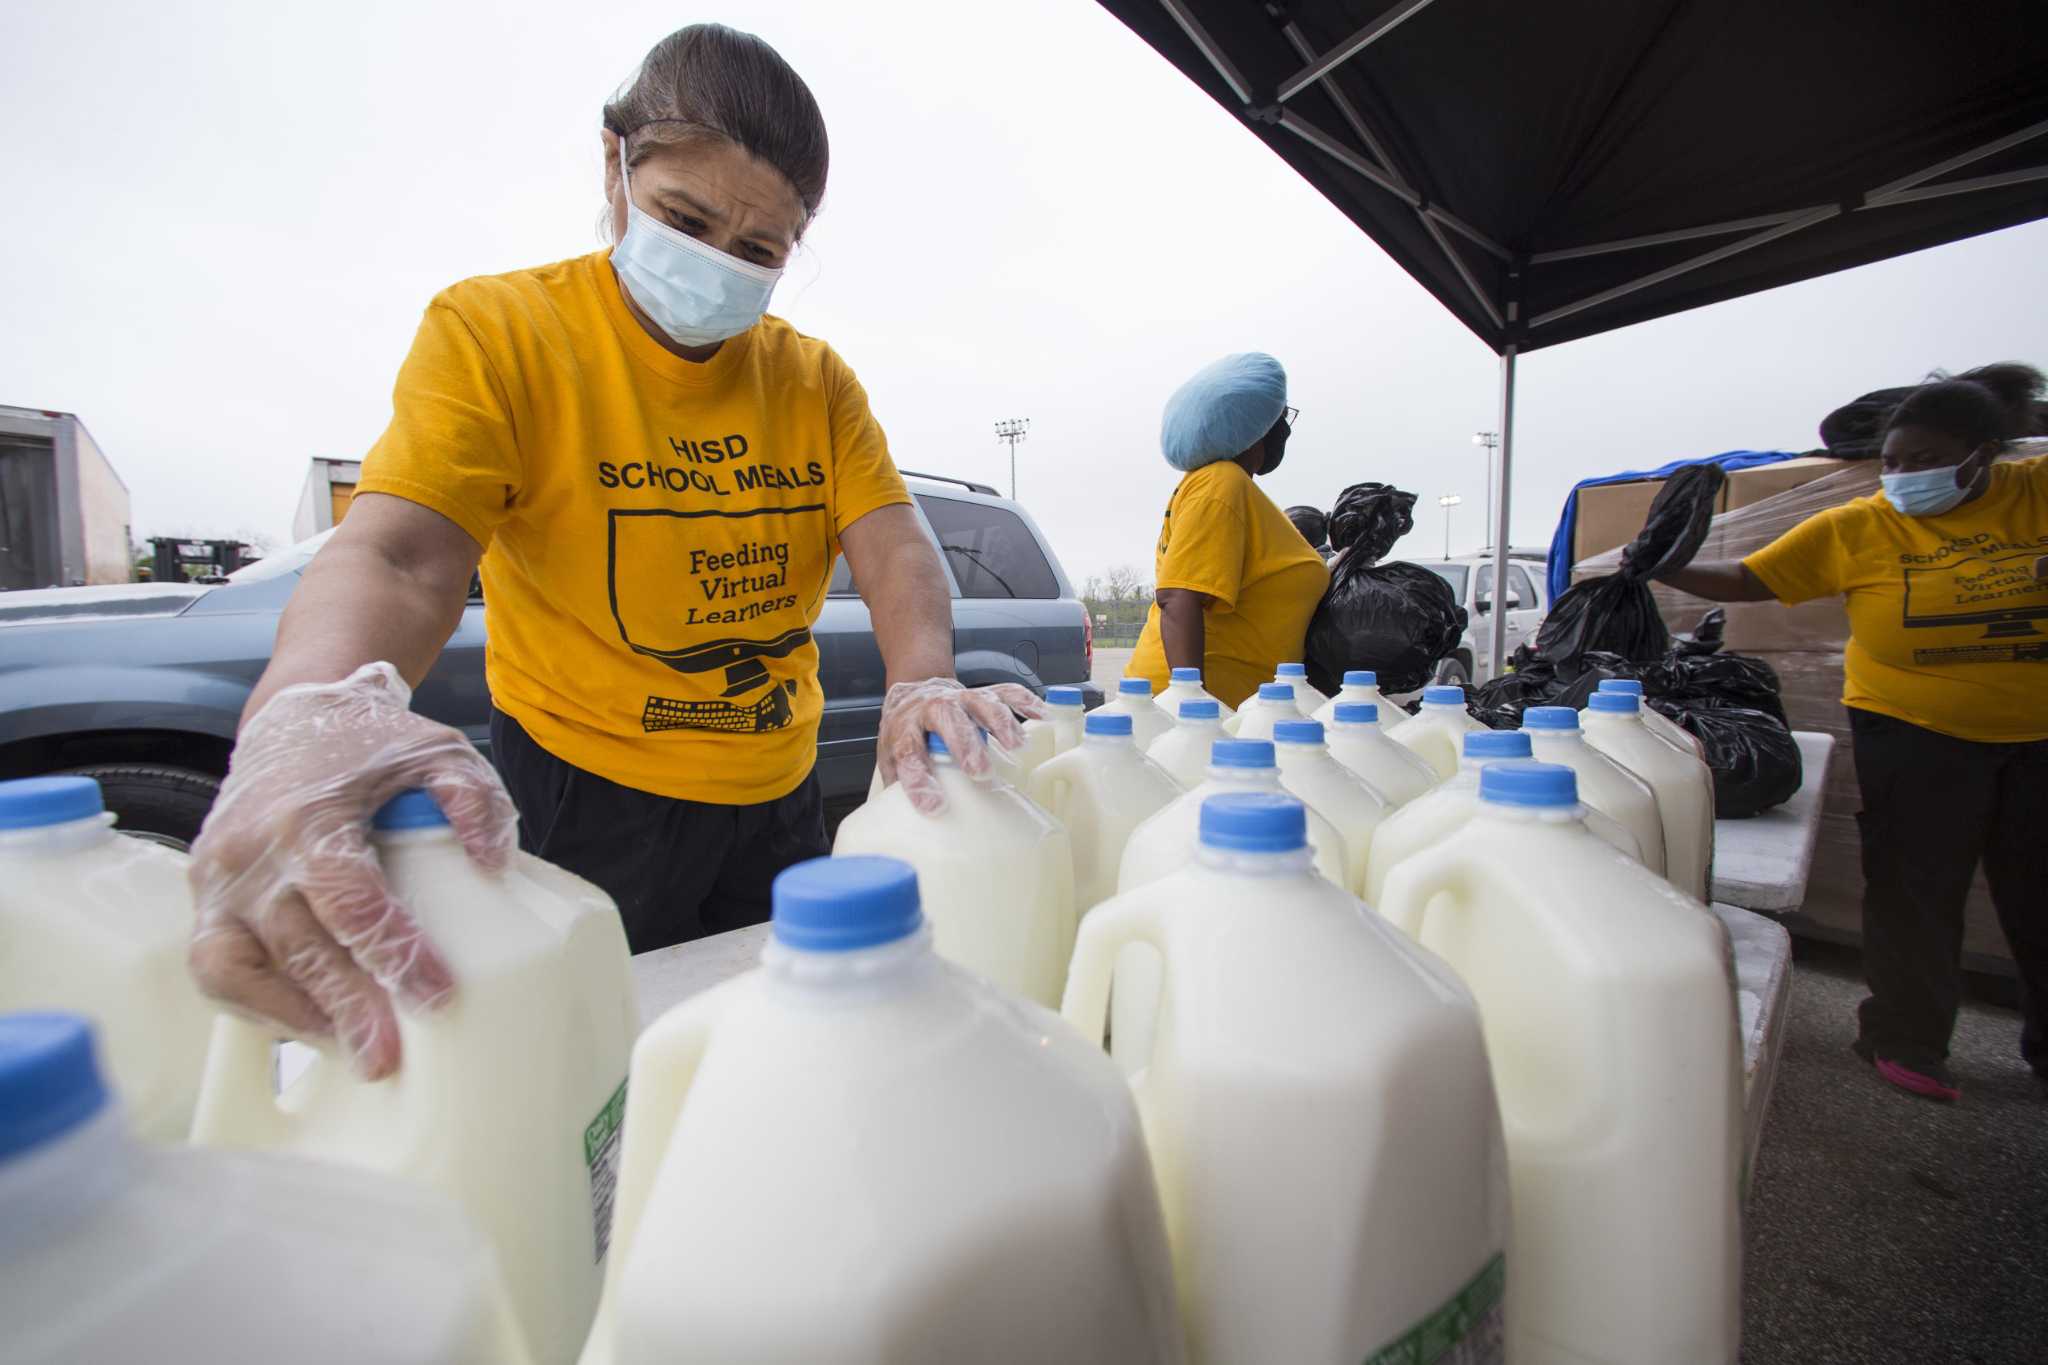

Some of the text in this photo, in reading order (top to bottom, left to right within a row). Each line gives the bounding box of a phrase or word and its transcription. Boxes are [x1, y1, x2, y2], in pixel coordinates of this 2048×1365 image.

[669, 434, 748, 462] HISD
[599, 461, 825, 495] SCHOOL MEALS
[690, 542, 788, 574] Feeding
[701, 568, 786, 601] Virtual
[686, 592, 797, 625] Learners
